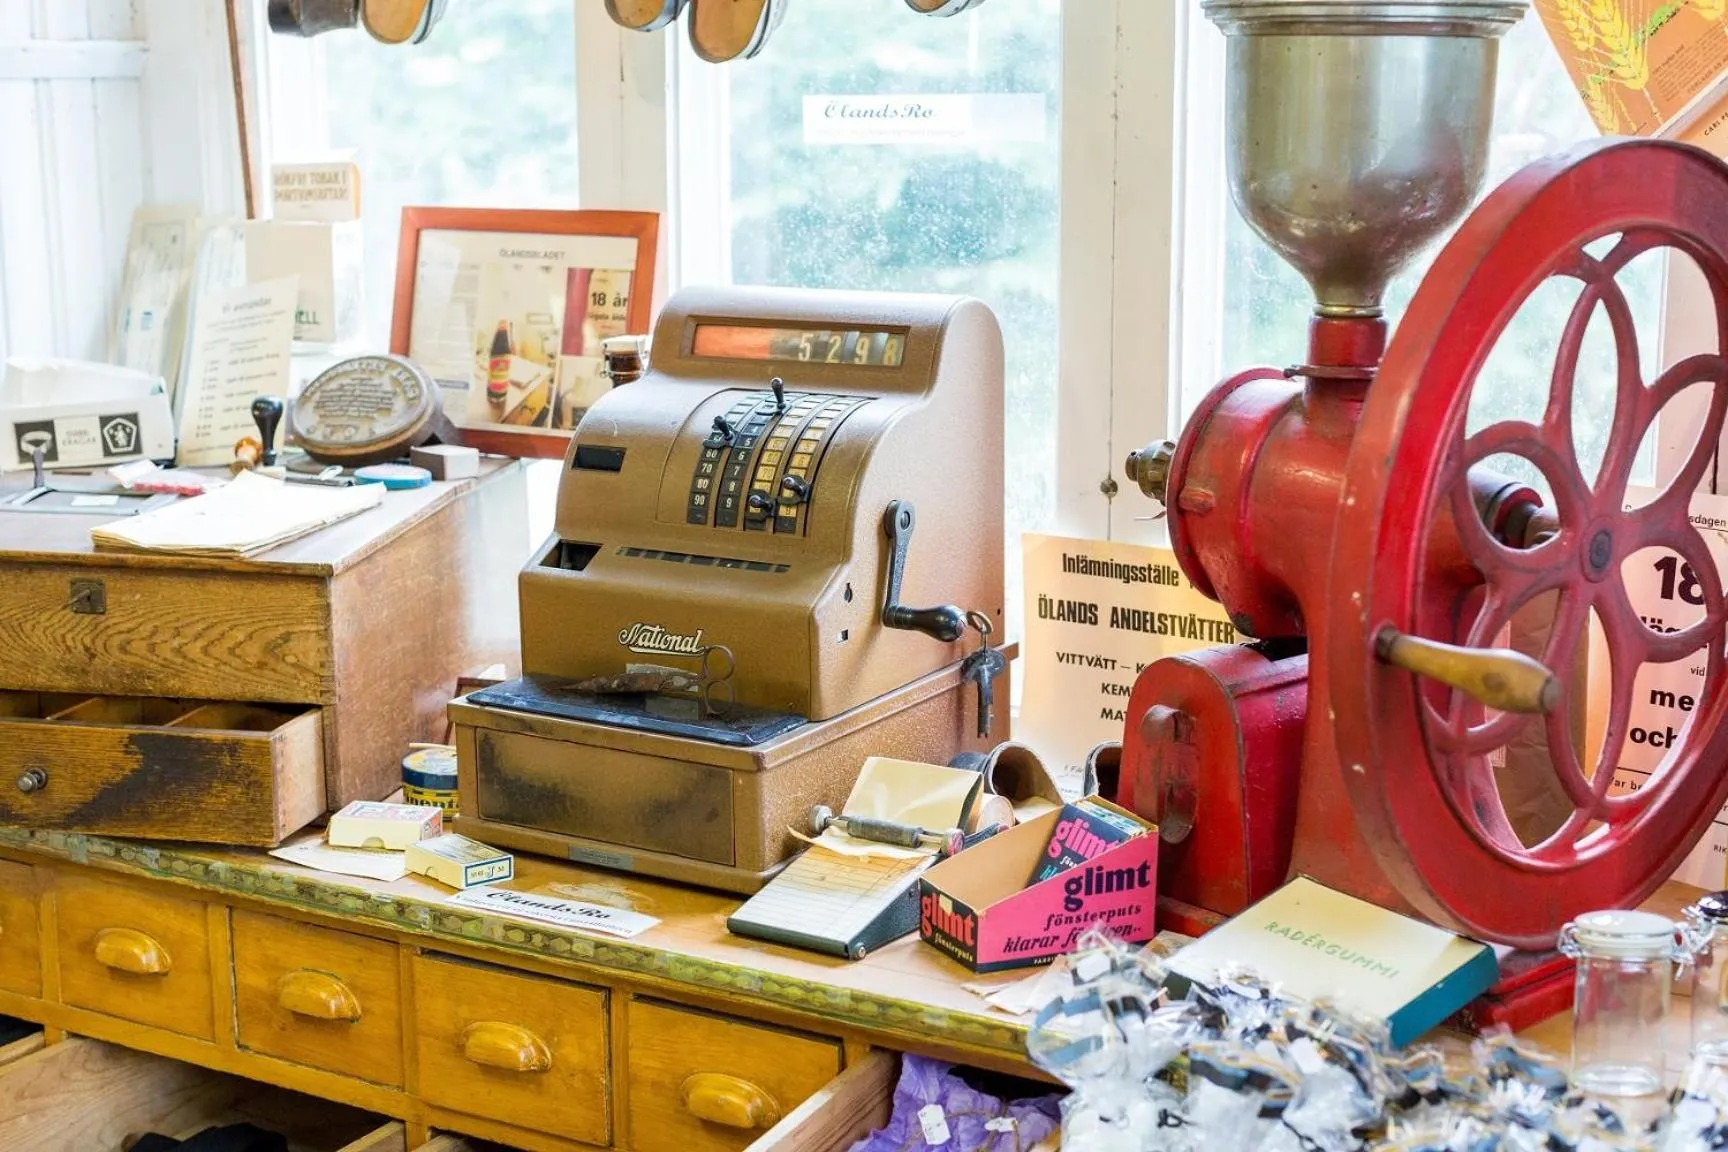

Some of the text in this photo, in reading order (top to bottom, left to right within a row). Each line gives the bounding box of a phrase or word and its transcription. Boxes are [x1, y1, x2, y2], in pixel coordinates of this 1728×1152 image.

[592, 292, 629, 308] 18 år
[738, 451, 746, 461] 6
[701, 463, 713, 474] 70
[734, 465, 741, 476] 7
[694, 494, 705, 506] 90
[726, 497, 732, 508] 9
[1688, 513, 1726, 529] sdagen
[1063, 553, 1179, 587] Inlämningsställe
[1652, 556, 1706, 605] 18
[1038, 594, 1235, 644] ÖLANDS ANDELSTVÄTTER
[619, 623, 704, 655] National
[1056, 651, 1117, 671] VITTVÄTT
[1101, 682, 1132, 697] KEM
[1650, 689, 1695, 711] me
[1100, 707, 1127, 721] MA
[1063, 861, 1151, 912] glimt
[921, 892, 975, 947] glimt
[1044, 904, 1142, 931] fönsterputs
[1003, 935, 1060, 953] klarar
[1263, 920, 1400, 980] RADÉRGUMMI
[1033, 953, 1056, 965] FABRI
